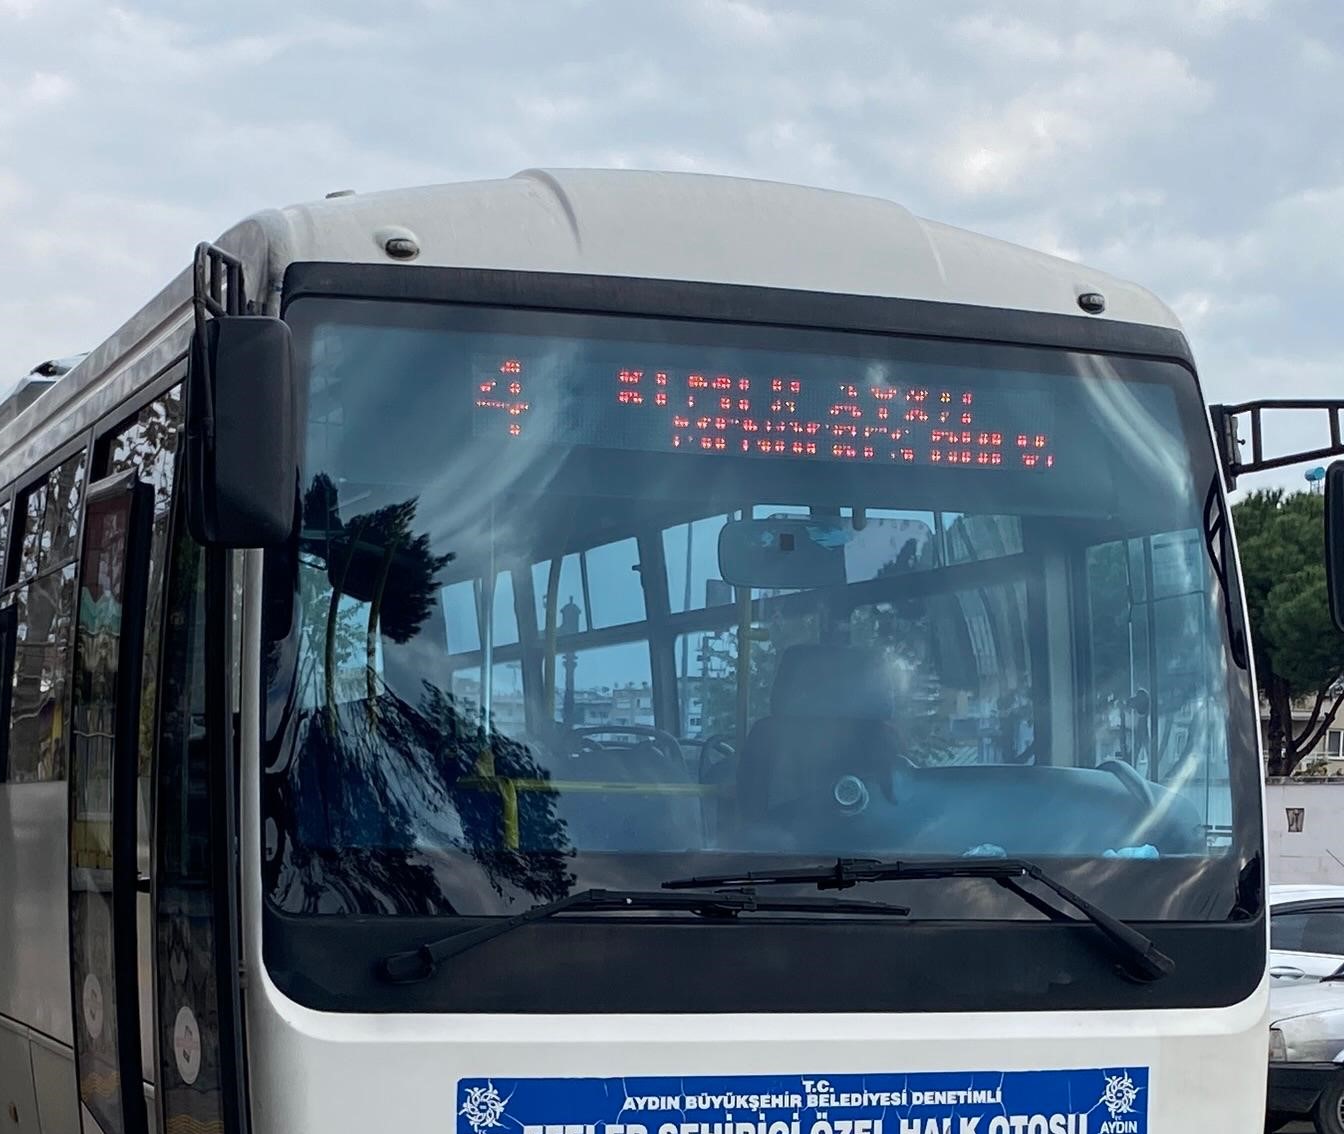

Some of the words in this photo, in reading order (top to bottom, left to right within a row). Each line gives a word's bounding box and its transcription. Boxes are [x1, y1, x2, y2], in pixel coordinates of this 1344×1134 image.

[802, 1080, 834, 1093] T.C.
[623, 1096, 680, 1111] AYDIN
[685, 1091, 802, 1112] BÜYÜKŞEHİR
[806, 1089, 907, 1108] BELEDİYESİ
[912, 1087, 1002, 1105] DENETİMLİ
[1100, 1120, 1138, 1134] AYDIN
